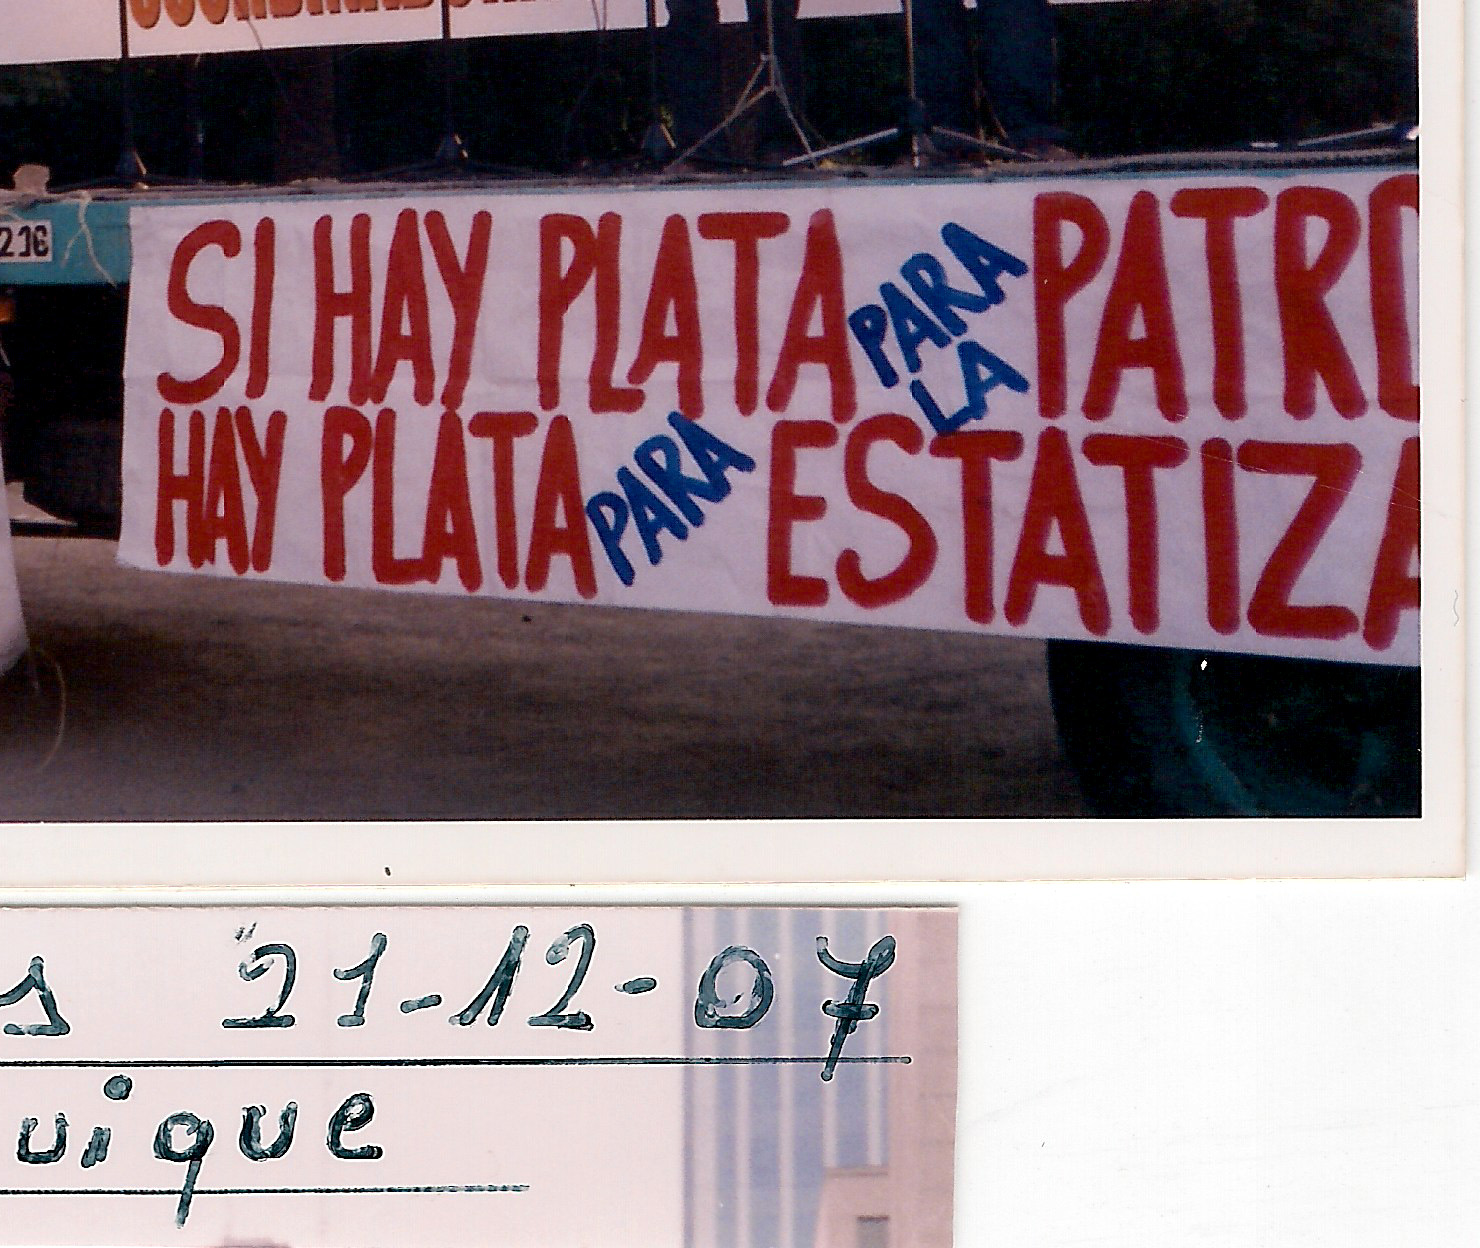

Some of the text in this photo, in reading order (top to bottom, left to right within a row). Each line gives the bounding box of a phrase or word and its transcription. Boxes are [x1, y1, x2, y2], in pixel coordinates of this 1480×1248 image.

[157, 216, 275, 404] SI
[308, 208, 492, 408] HAY
[537, 210, 857, 424] PLATA
[848, 222, 1029, 388] PARA
[910, 339, 1030, 436] LA
[154, 405, 287, 575] HAY
[319, 405, 599, 600] PLATA
[585, 411, 757, 587] PARA
